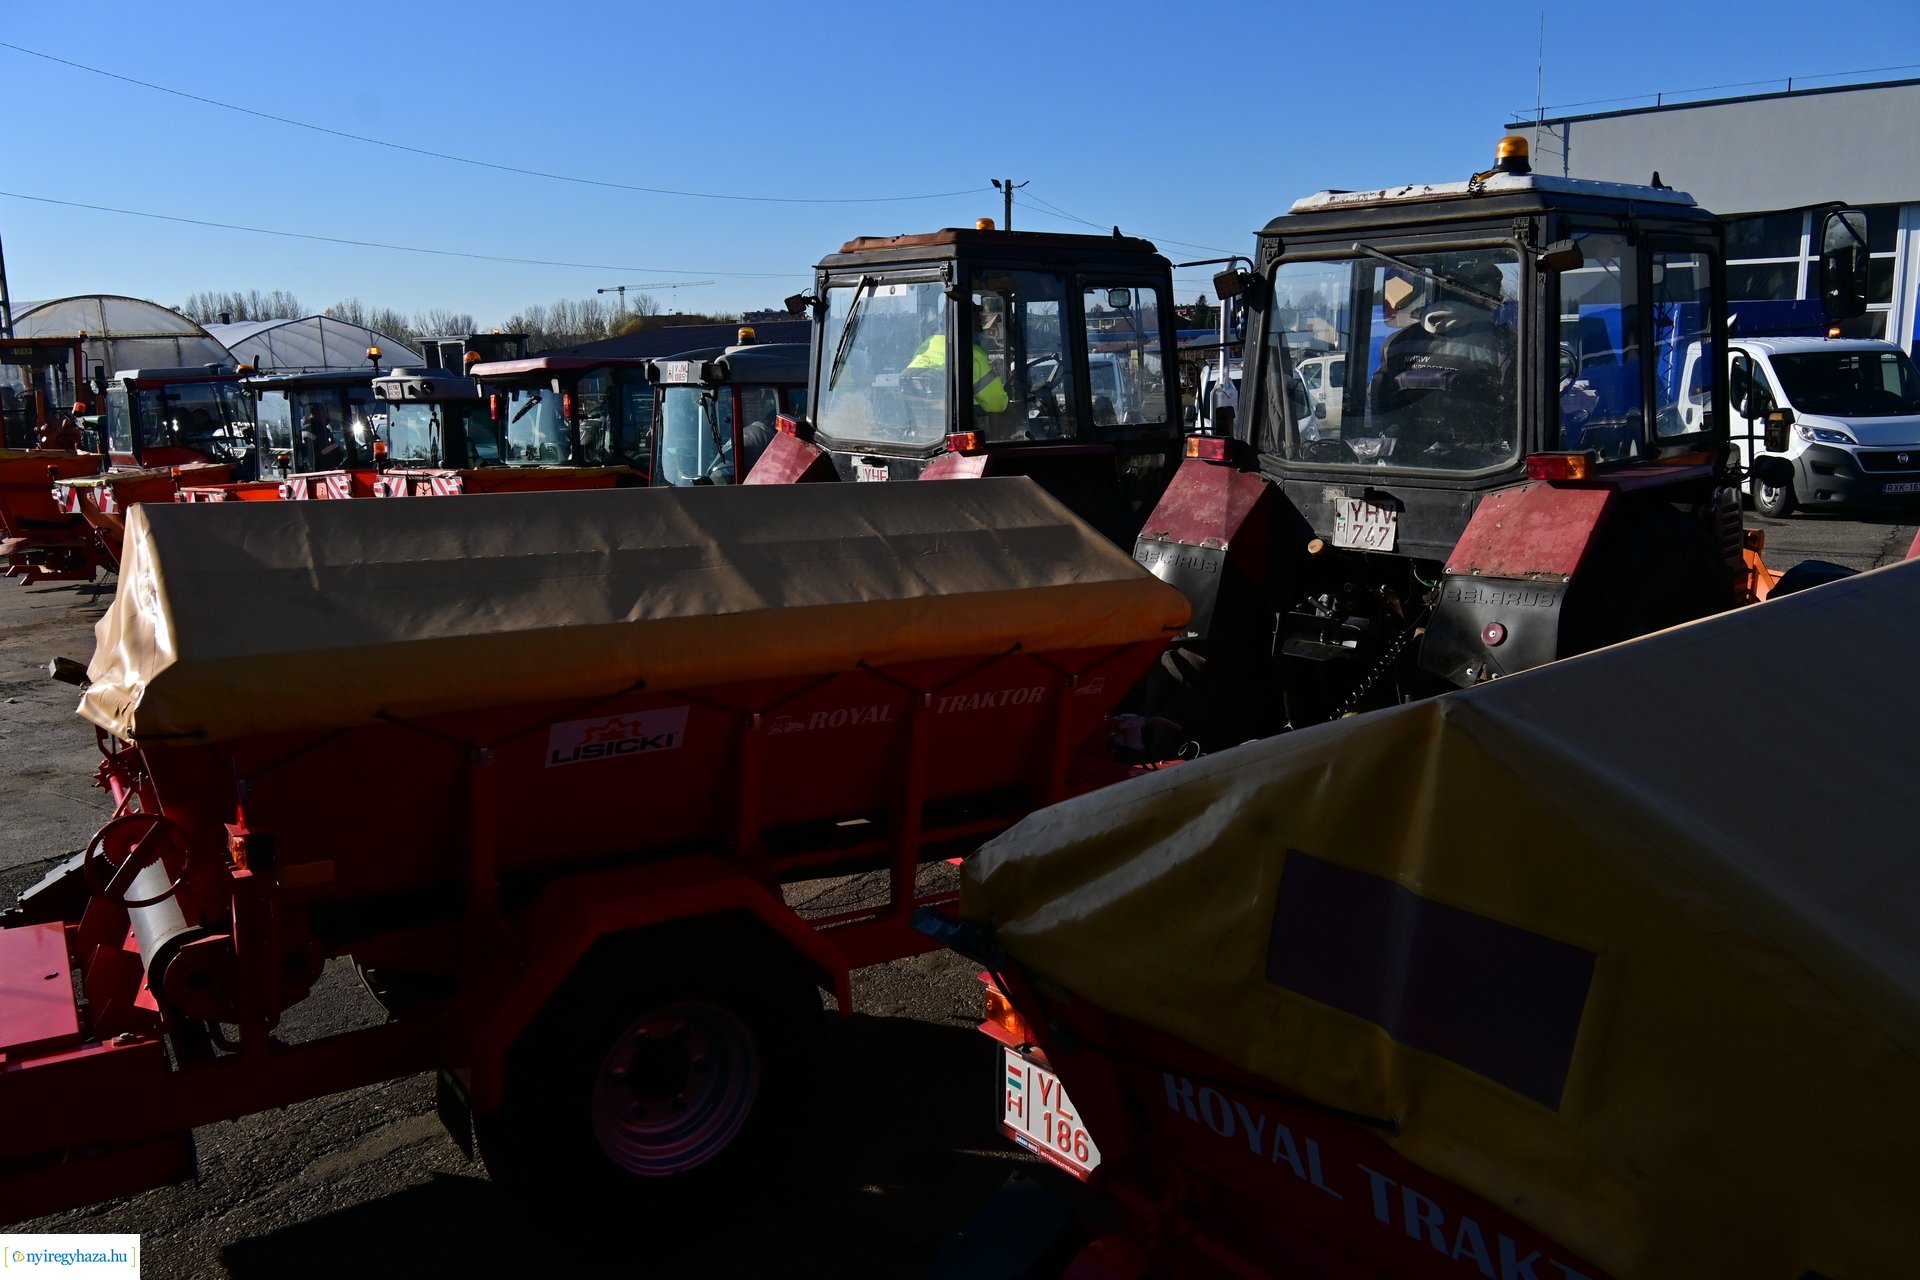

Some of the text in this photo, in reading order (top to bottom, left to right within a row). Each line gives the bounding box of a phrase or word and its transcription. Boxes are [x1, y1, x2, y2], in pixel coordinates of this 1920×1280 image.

[1887, 483, 1920, 492] RXK-16
[1350, 500, 1396, 525] YHV
[1337, 522, 1346, 532] H
[1351, 524, 1391, 547] 747
[1138, 551, 1218, 573] BELARUS
[1448, 589, 1556, 608] BELARUS
[808, 685, 1046, 730] ROYAL TRAKTOR
[551, 732, 674, 764] LISICKI
[1008, 1090, 1022, 1118] H
[1043, 1111, 1089, 1163] 186
[1162, 1071, 1344, 1201] ROYAL
